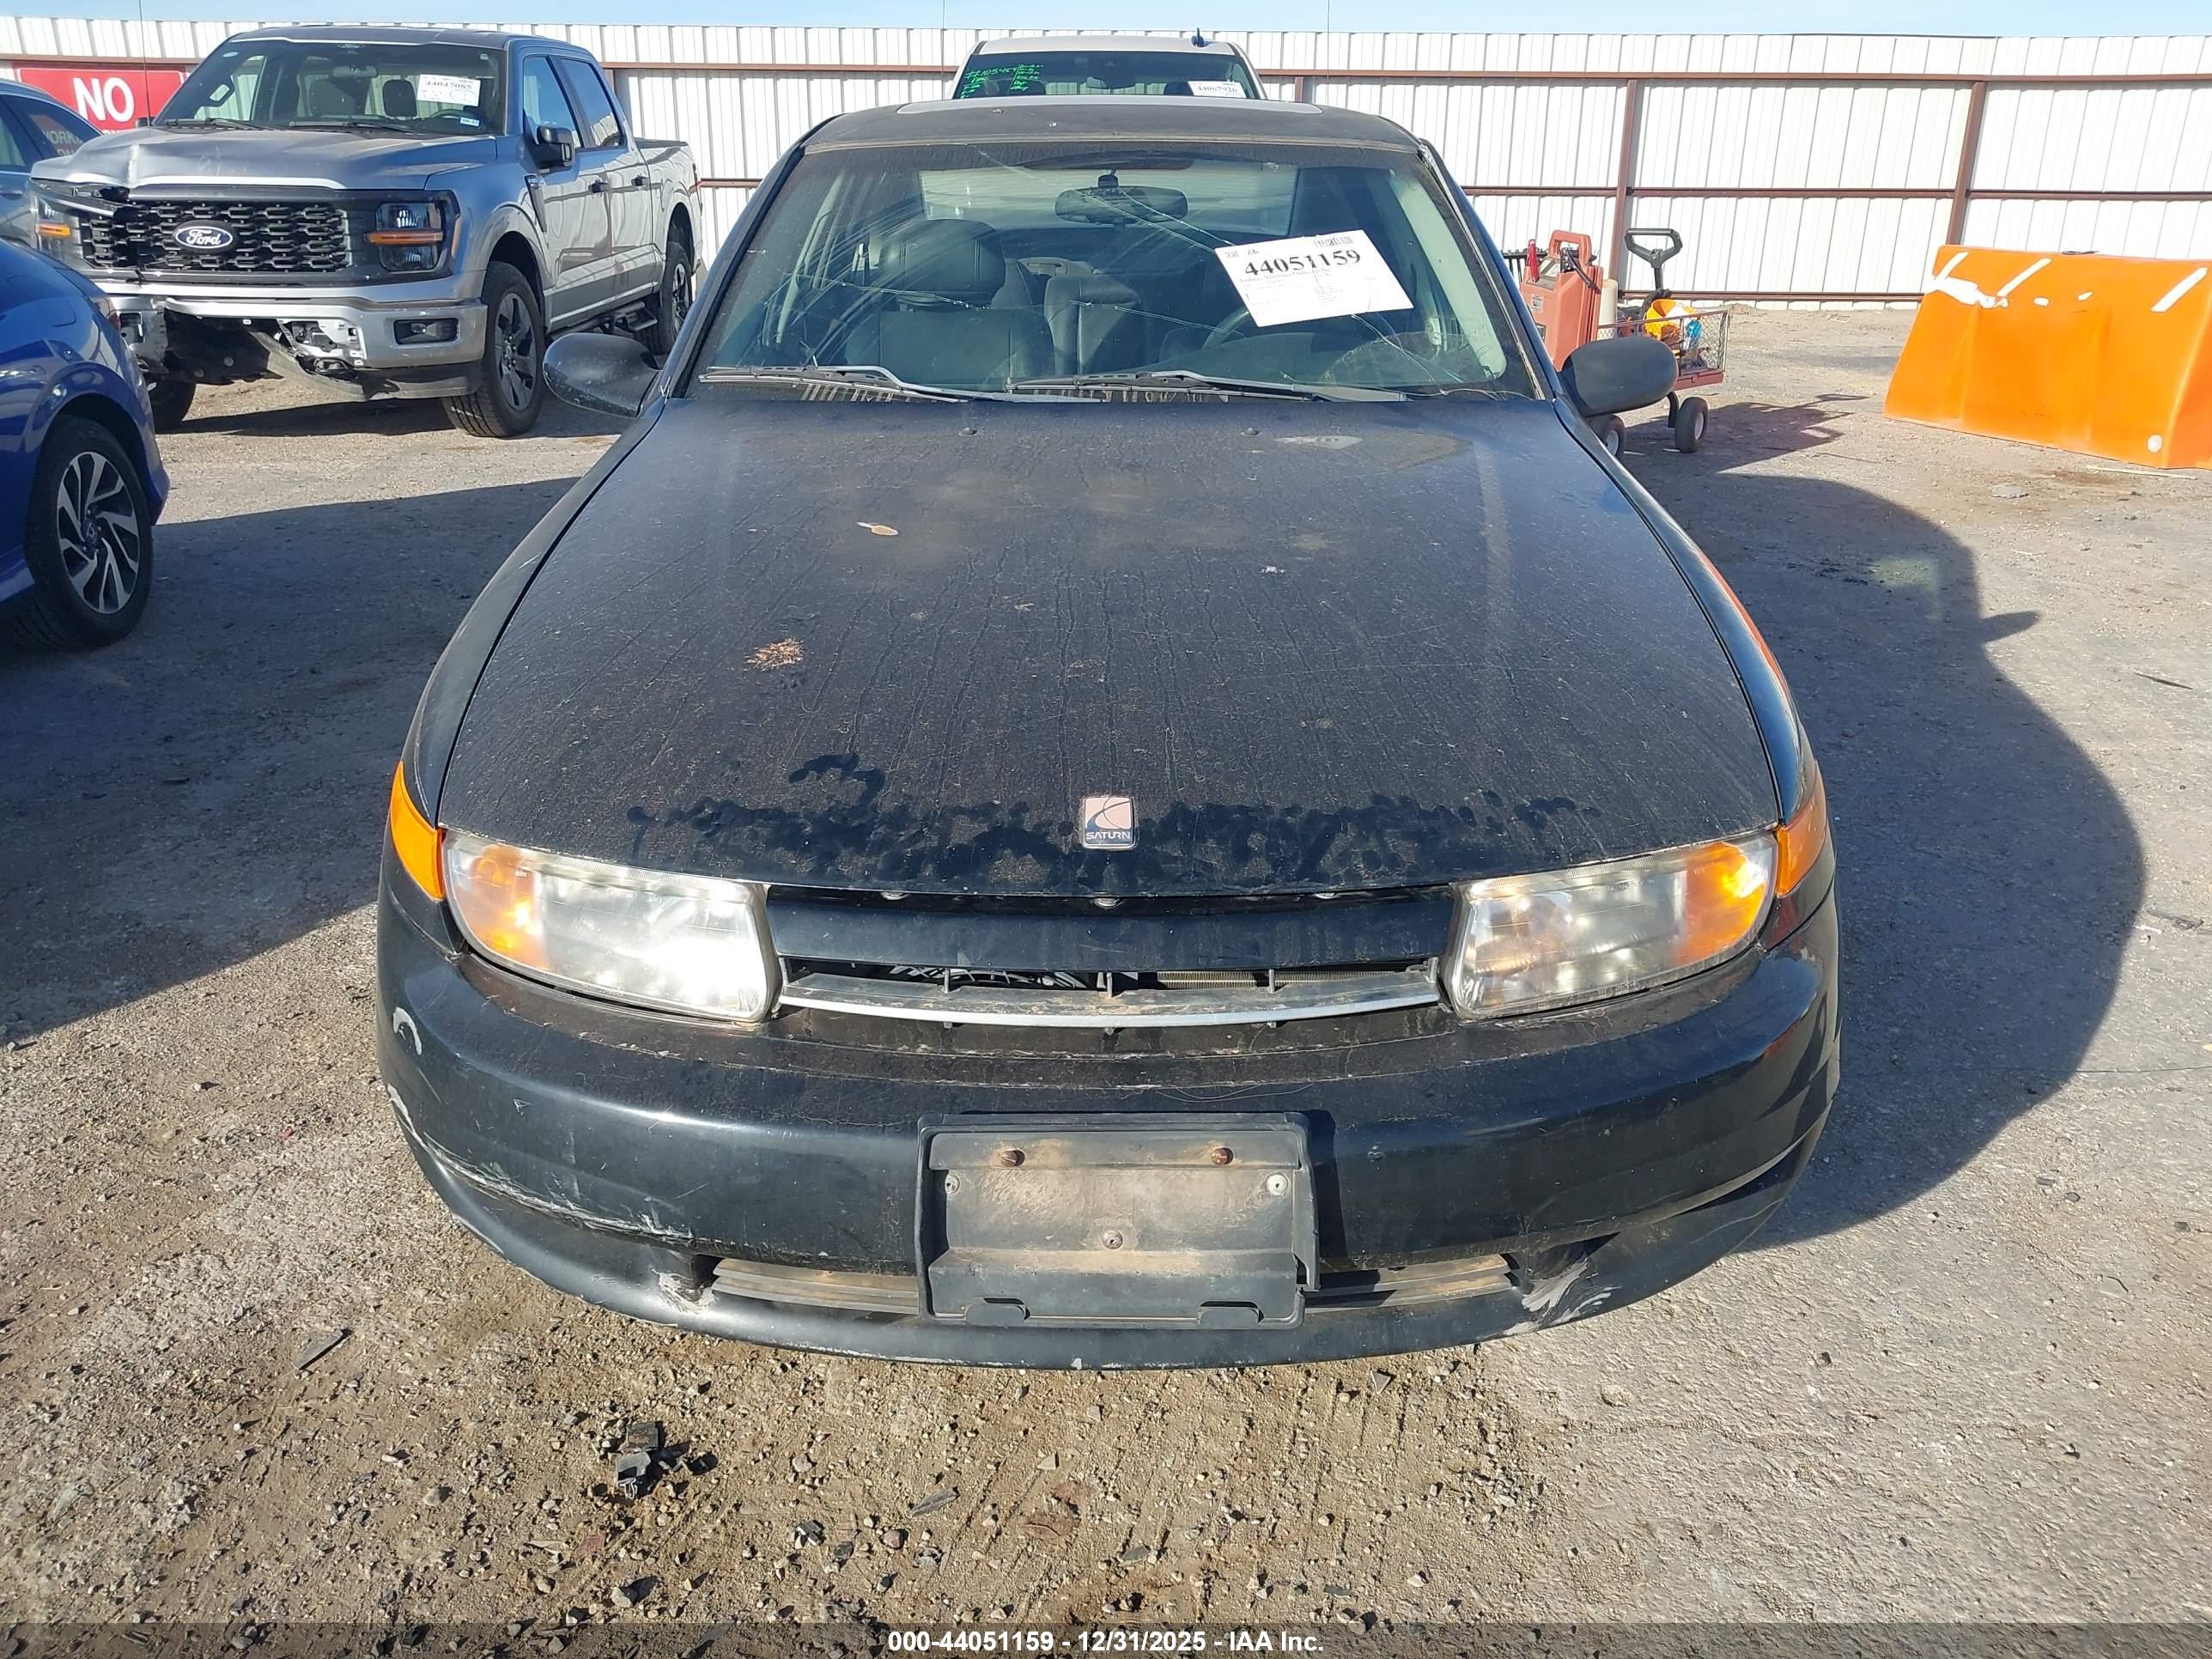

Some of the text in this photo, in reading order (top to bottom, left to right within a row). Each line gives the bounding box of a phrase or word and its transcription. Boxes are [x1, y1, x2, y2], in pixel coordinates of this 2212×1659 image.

[73, 77, 134, 123] NO
[186, 228, 222, 246] Ford
[1244, 249, 1361, 276] 44051159
[1085, 830, 1131, 840] SATURN
